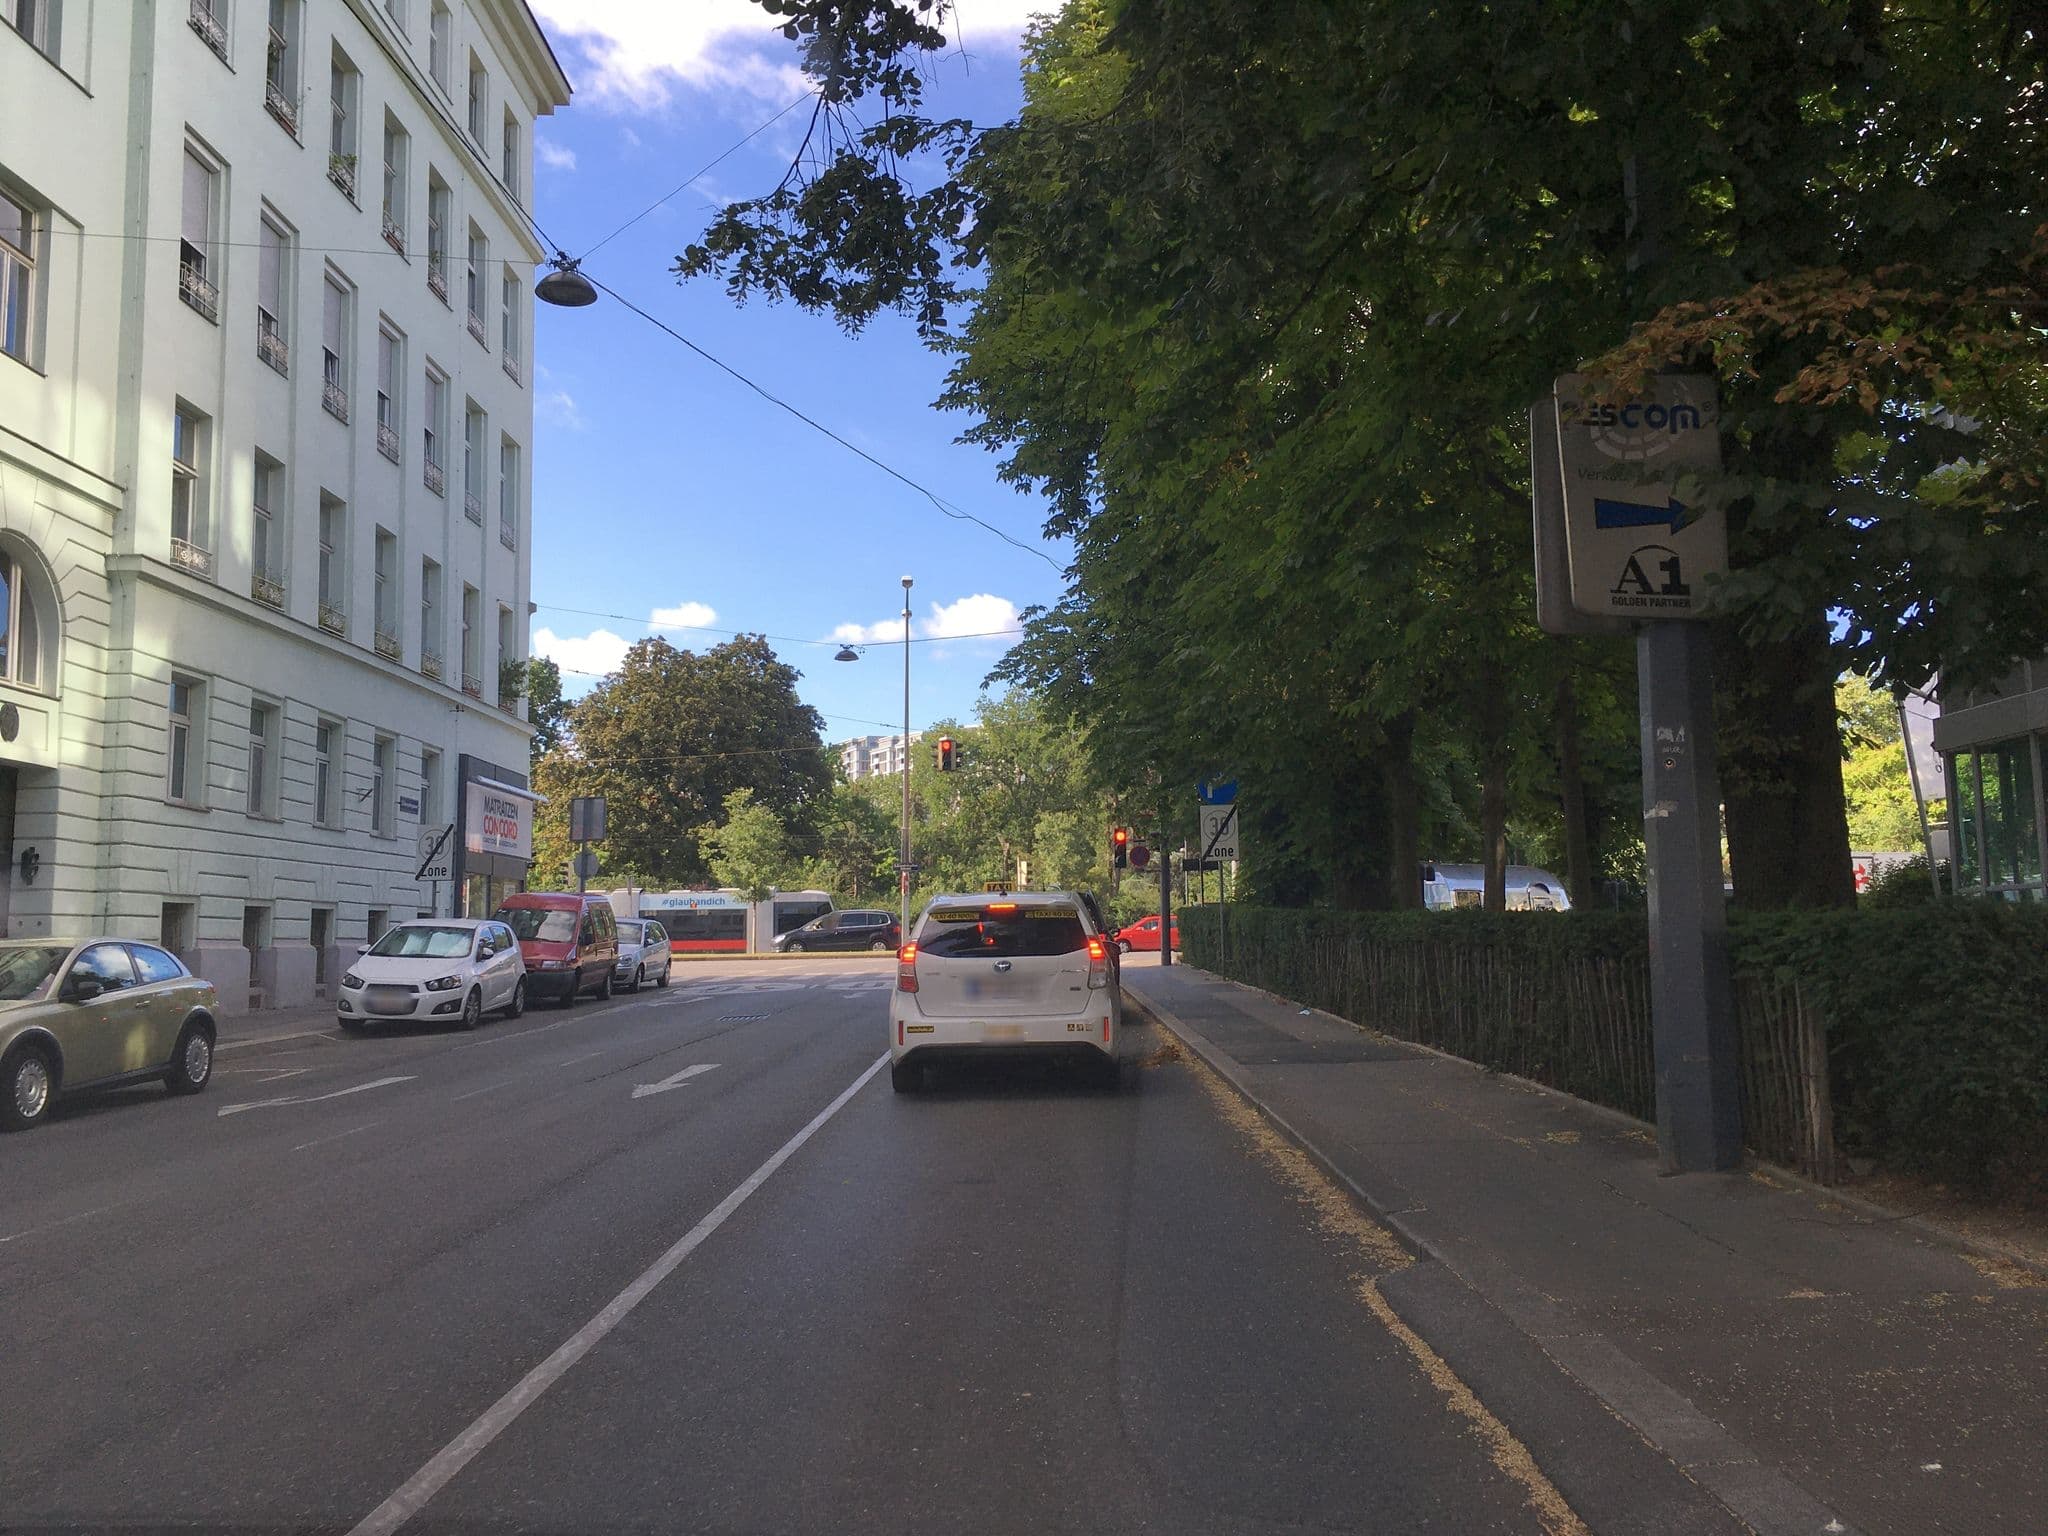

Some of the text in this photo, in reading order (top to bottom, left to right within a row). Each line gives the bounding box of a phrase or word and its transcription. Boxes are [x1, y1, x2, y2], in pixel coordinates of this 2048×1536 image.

[1610, 555, 1690, 595] A1
[1611, 596, 1691, 608] GOLDEN PARTNER
[484, 796, 519, 820] MATRATZEN
[483, 815, 518, 840] CONCORD
[1210, 816, 1229, 835] 30
[425, 835, 445, 855] 30
[662, 897, 726, 908] #glaubandich
